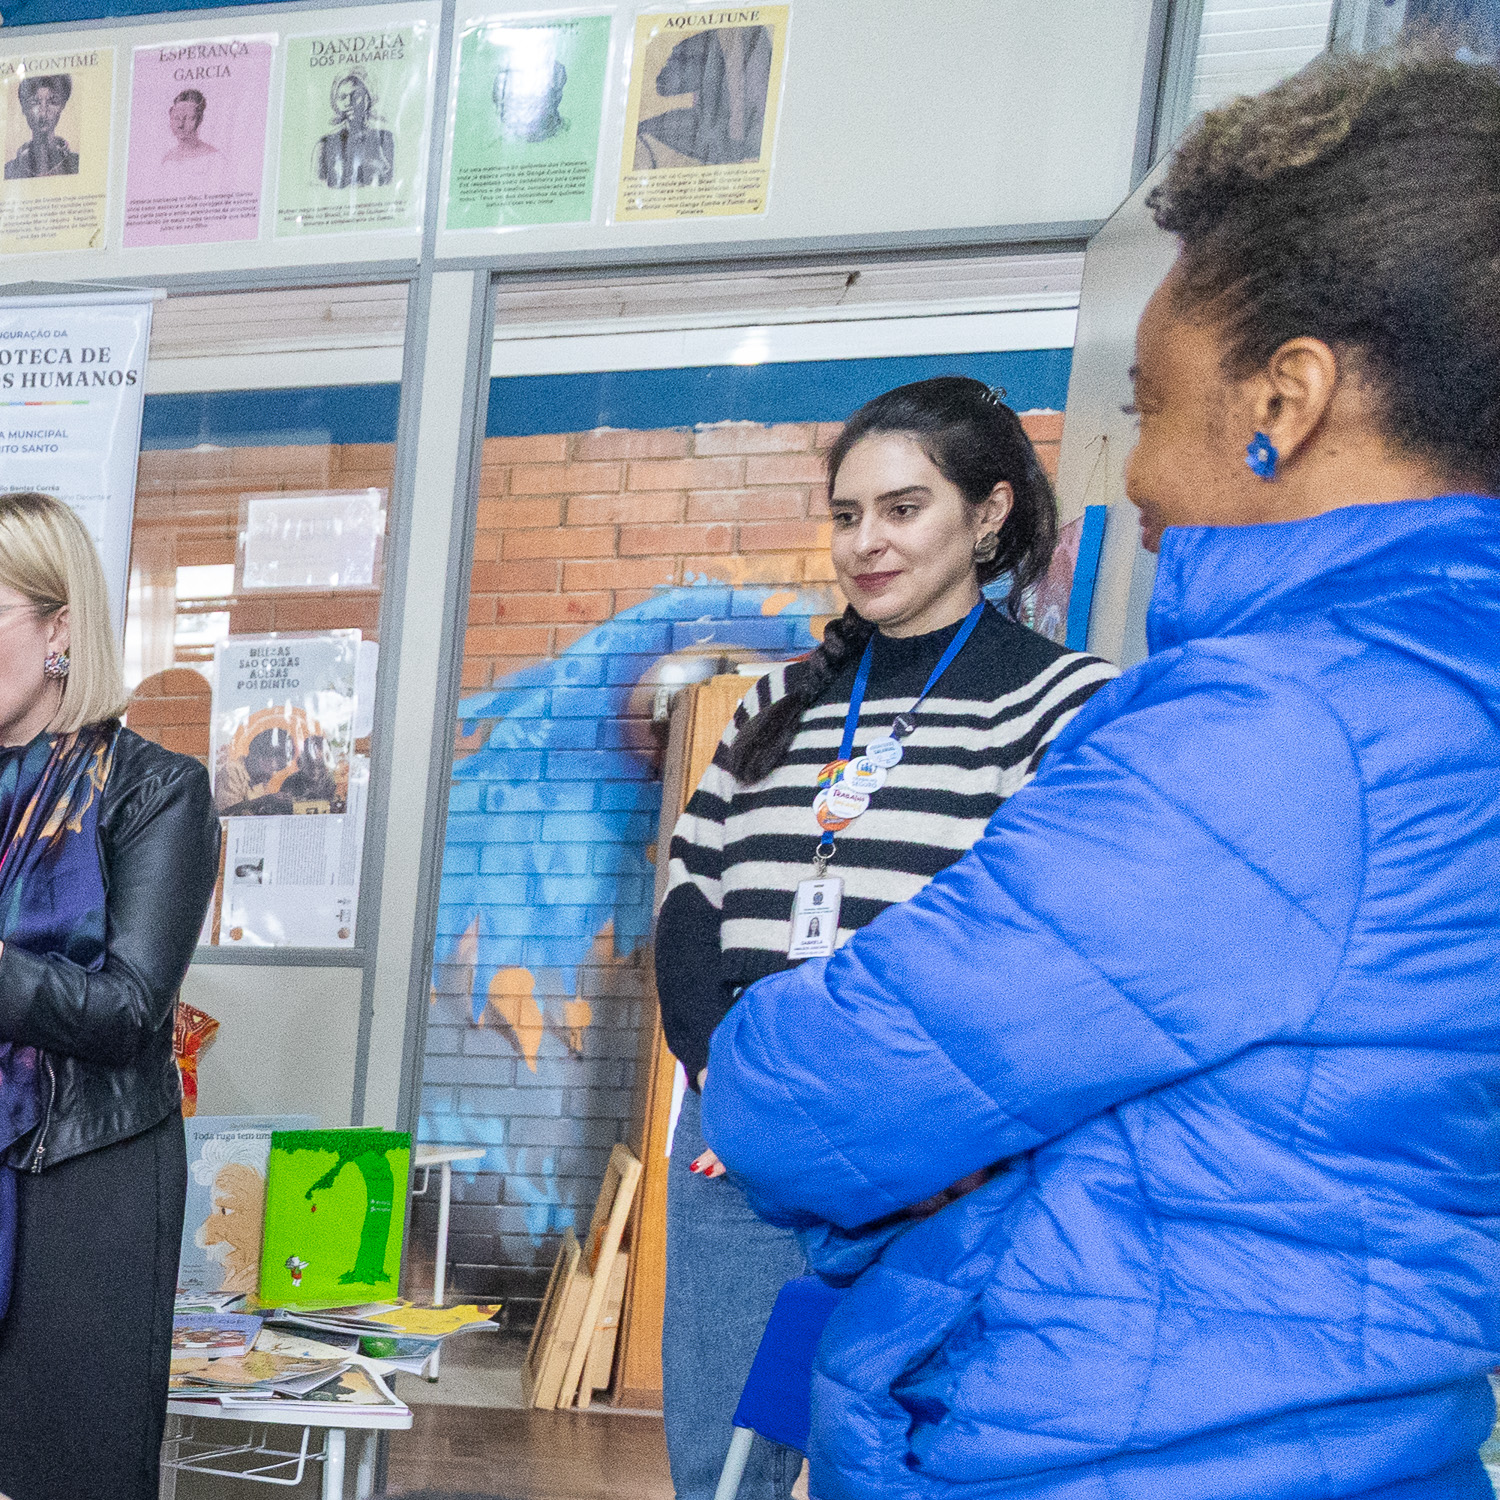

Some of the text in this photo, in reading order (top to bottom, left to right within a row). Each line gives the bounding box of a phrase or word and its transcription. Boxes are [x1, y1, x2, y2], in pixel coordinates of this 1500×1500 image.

[664, 10, 761, 29] AQUALTUNE
[158, 40, 250, 63] ESPERANÇA
[309, 49, 405, 68] DOS PALMARES
[173, 64, 232, 82] GARCIA
[54, 328, 69, 339] DA
[80, 346, 112, 365] DE
[20, 368, 139, 389] HUMANOS
[8, 428, 69, 440] MUNICIPAL
[21, 443, 60, 454] SANTO
[260, 678, 300, 690] DENTRO
[216, 1133, 236, 1142] ruga
